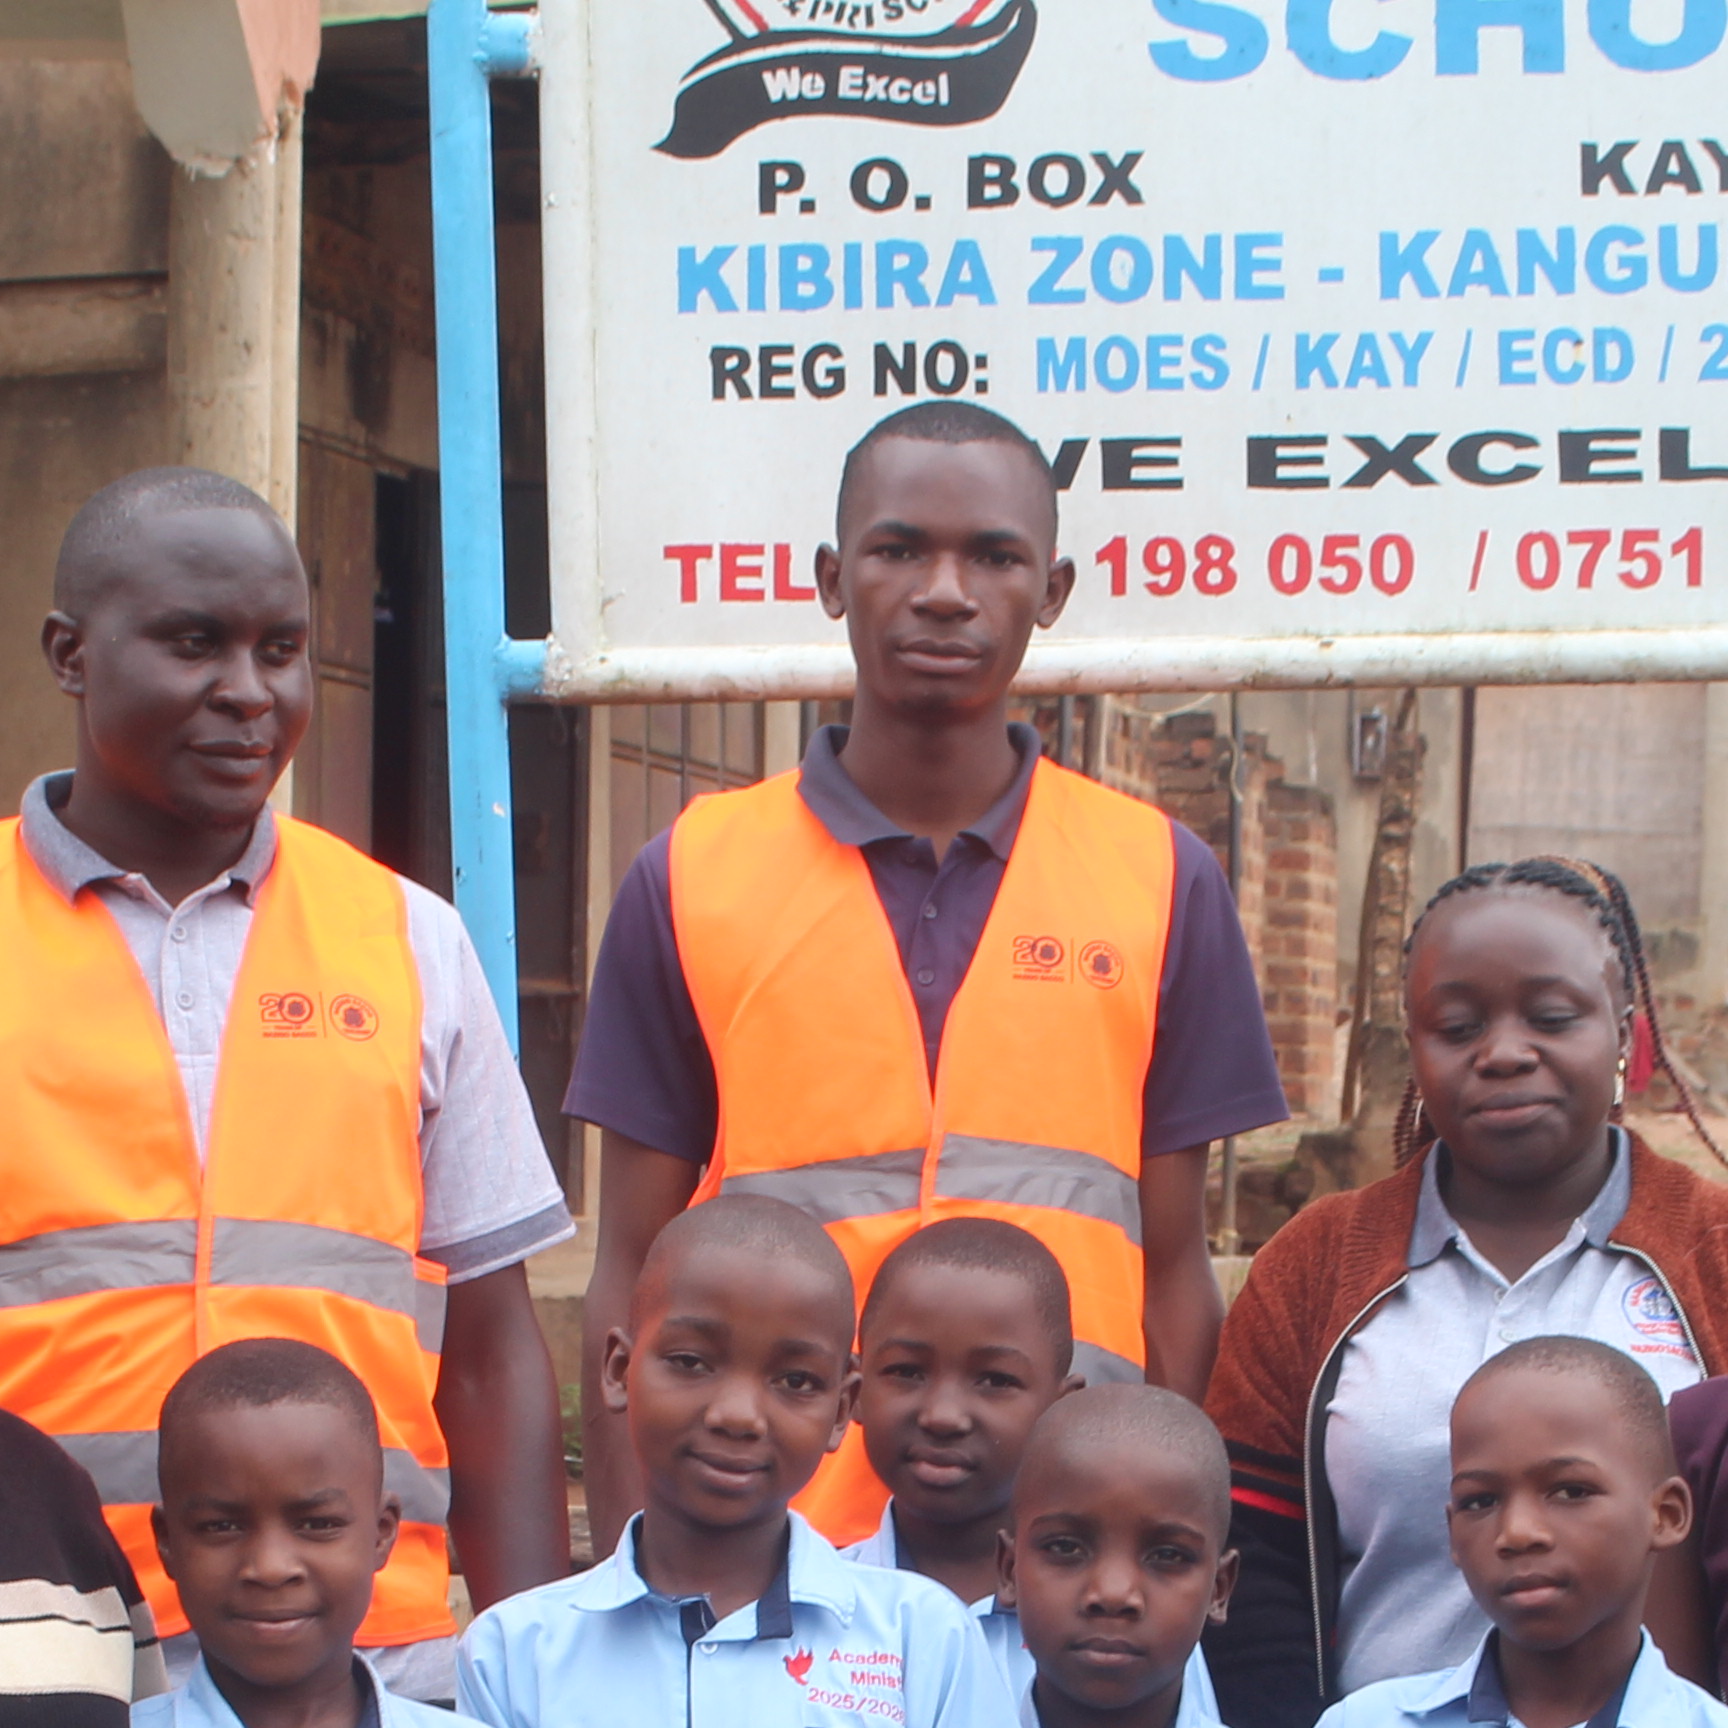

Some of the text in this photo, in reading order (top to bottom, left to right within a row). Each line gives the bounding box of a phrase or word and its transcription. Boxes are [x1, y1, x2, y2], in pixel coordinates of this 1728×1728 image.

[761, 65, 950, 105] We Excel
[757, 151, 1145, 214] P. O. BOX
[677, 238, 998, 314] KIBIRA
[1027, 232, 1286, 304] ZONE
[709, 342, 846, 400] REG
[873, 340, 989, 396] NO:
[1036, 333, 1231, 393] MOES
[1295, 331, 1434, 389] KAY
[1497, 326, 1636, 385] ECD
[1095, 535, 1238, 597] 198
[1268, 534, 1415, 597] 050
[1516, 527, 1703, 590] 0751
